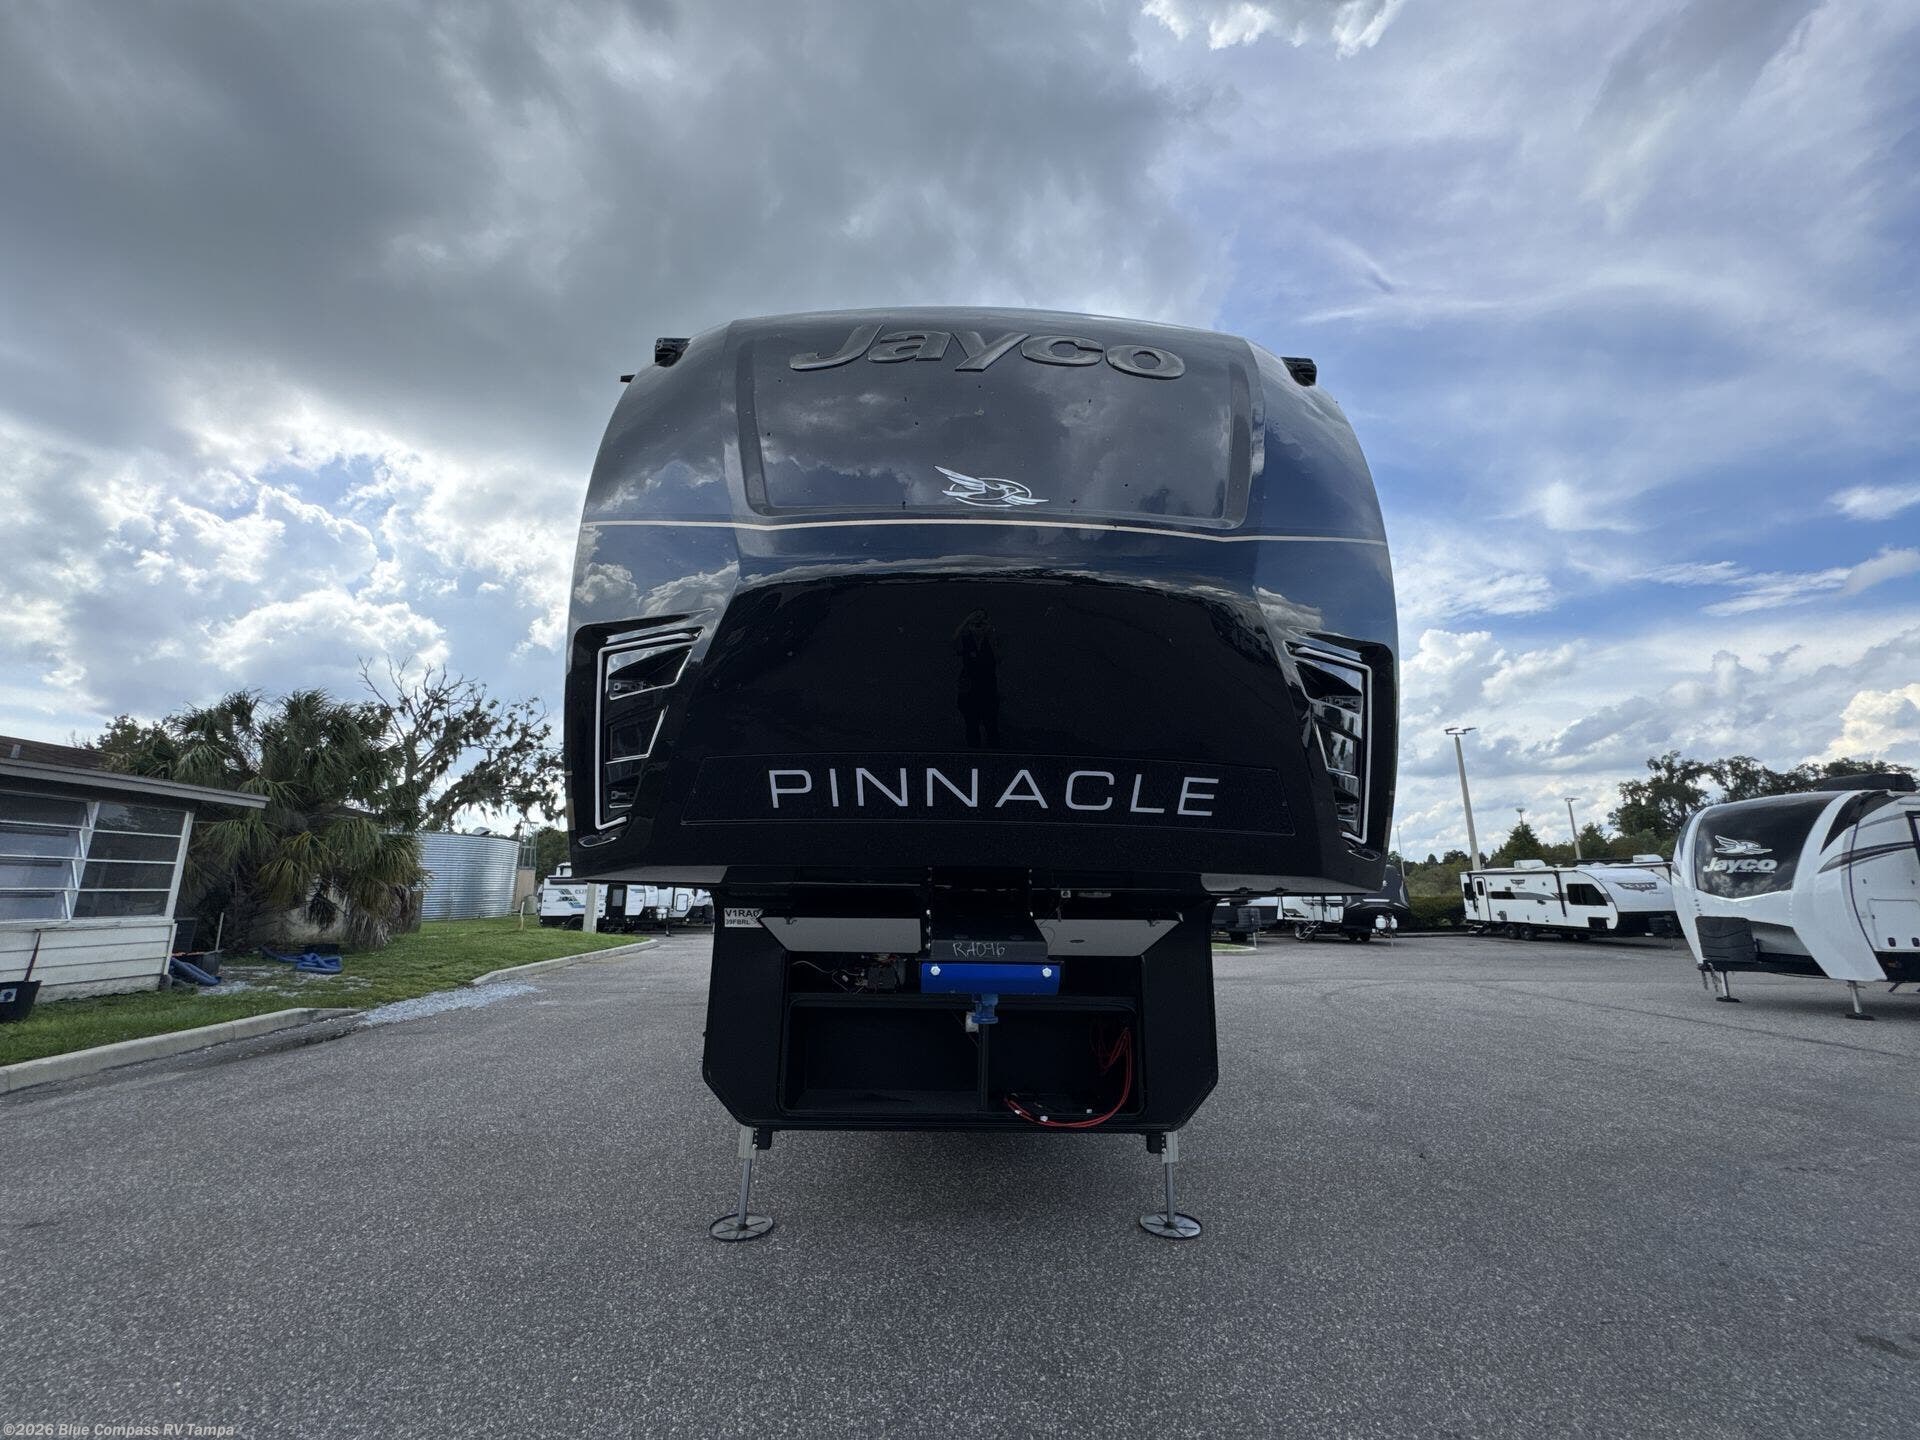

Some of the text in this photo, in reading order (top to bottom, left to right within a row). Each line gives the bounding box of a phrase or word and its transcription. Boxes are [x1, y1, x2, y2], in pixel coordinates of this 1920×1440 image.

[789, 323, 1186, 380] Jayco
[768, 767, 1220, 817] PINNACLE
[1702, 857, 1778, 874] Jayco
